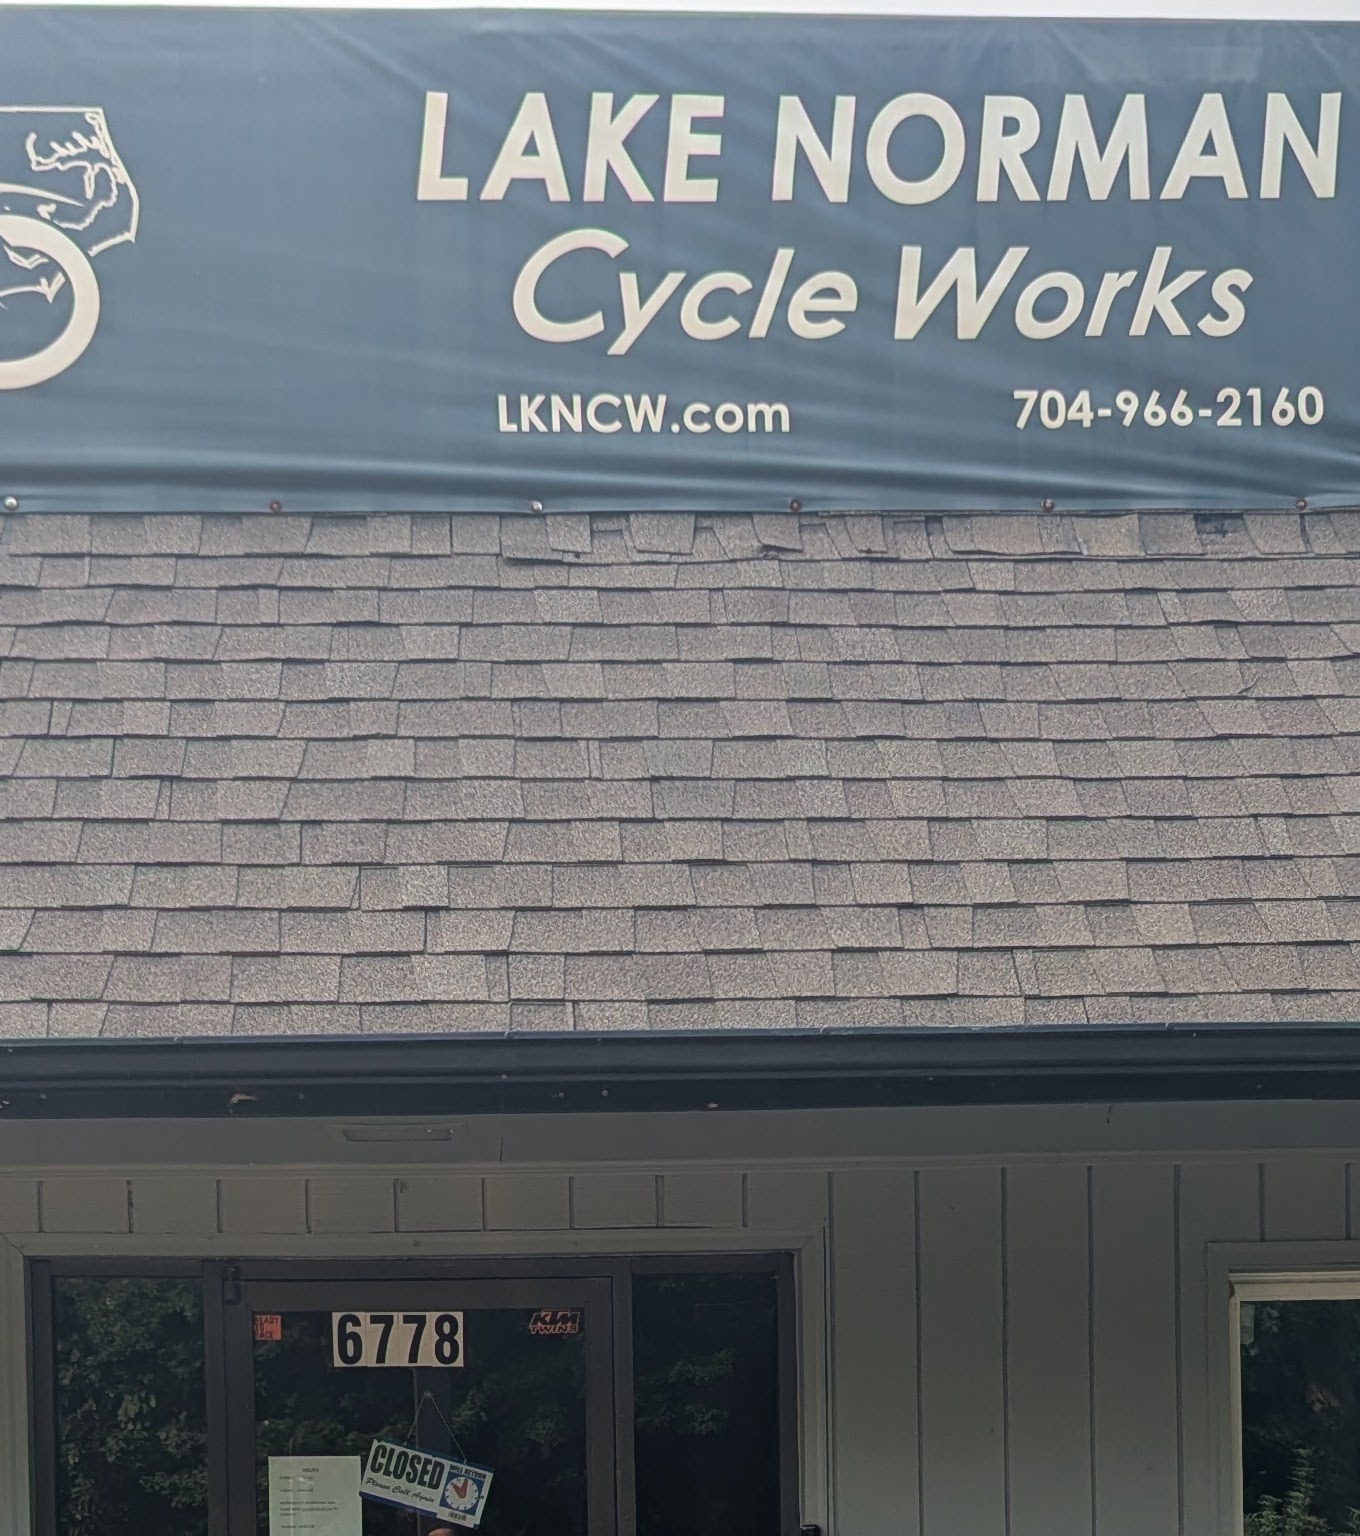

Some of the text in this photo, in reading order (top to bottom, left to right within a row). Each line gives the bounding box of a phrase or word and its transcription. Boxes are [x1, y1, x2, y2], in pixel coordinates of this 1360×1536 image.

[416, 90, 1342, 205] LAKE NORMAN
[512, 228, 1254, 355] Cycle Works
[498, 393, 790, 434] LKNCW.com
[1013, 386, 1324, 430] 704-966-2160
[337, 1314, 460, 1365] 6778
[530, 1309, 579, 1326] KTM
[370, 1444, 445, 1490] CLOSED
[391, 1485, 411, 1496] Call
